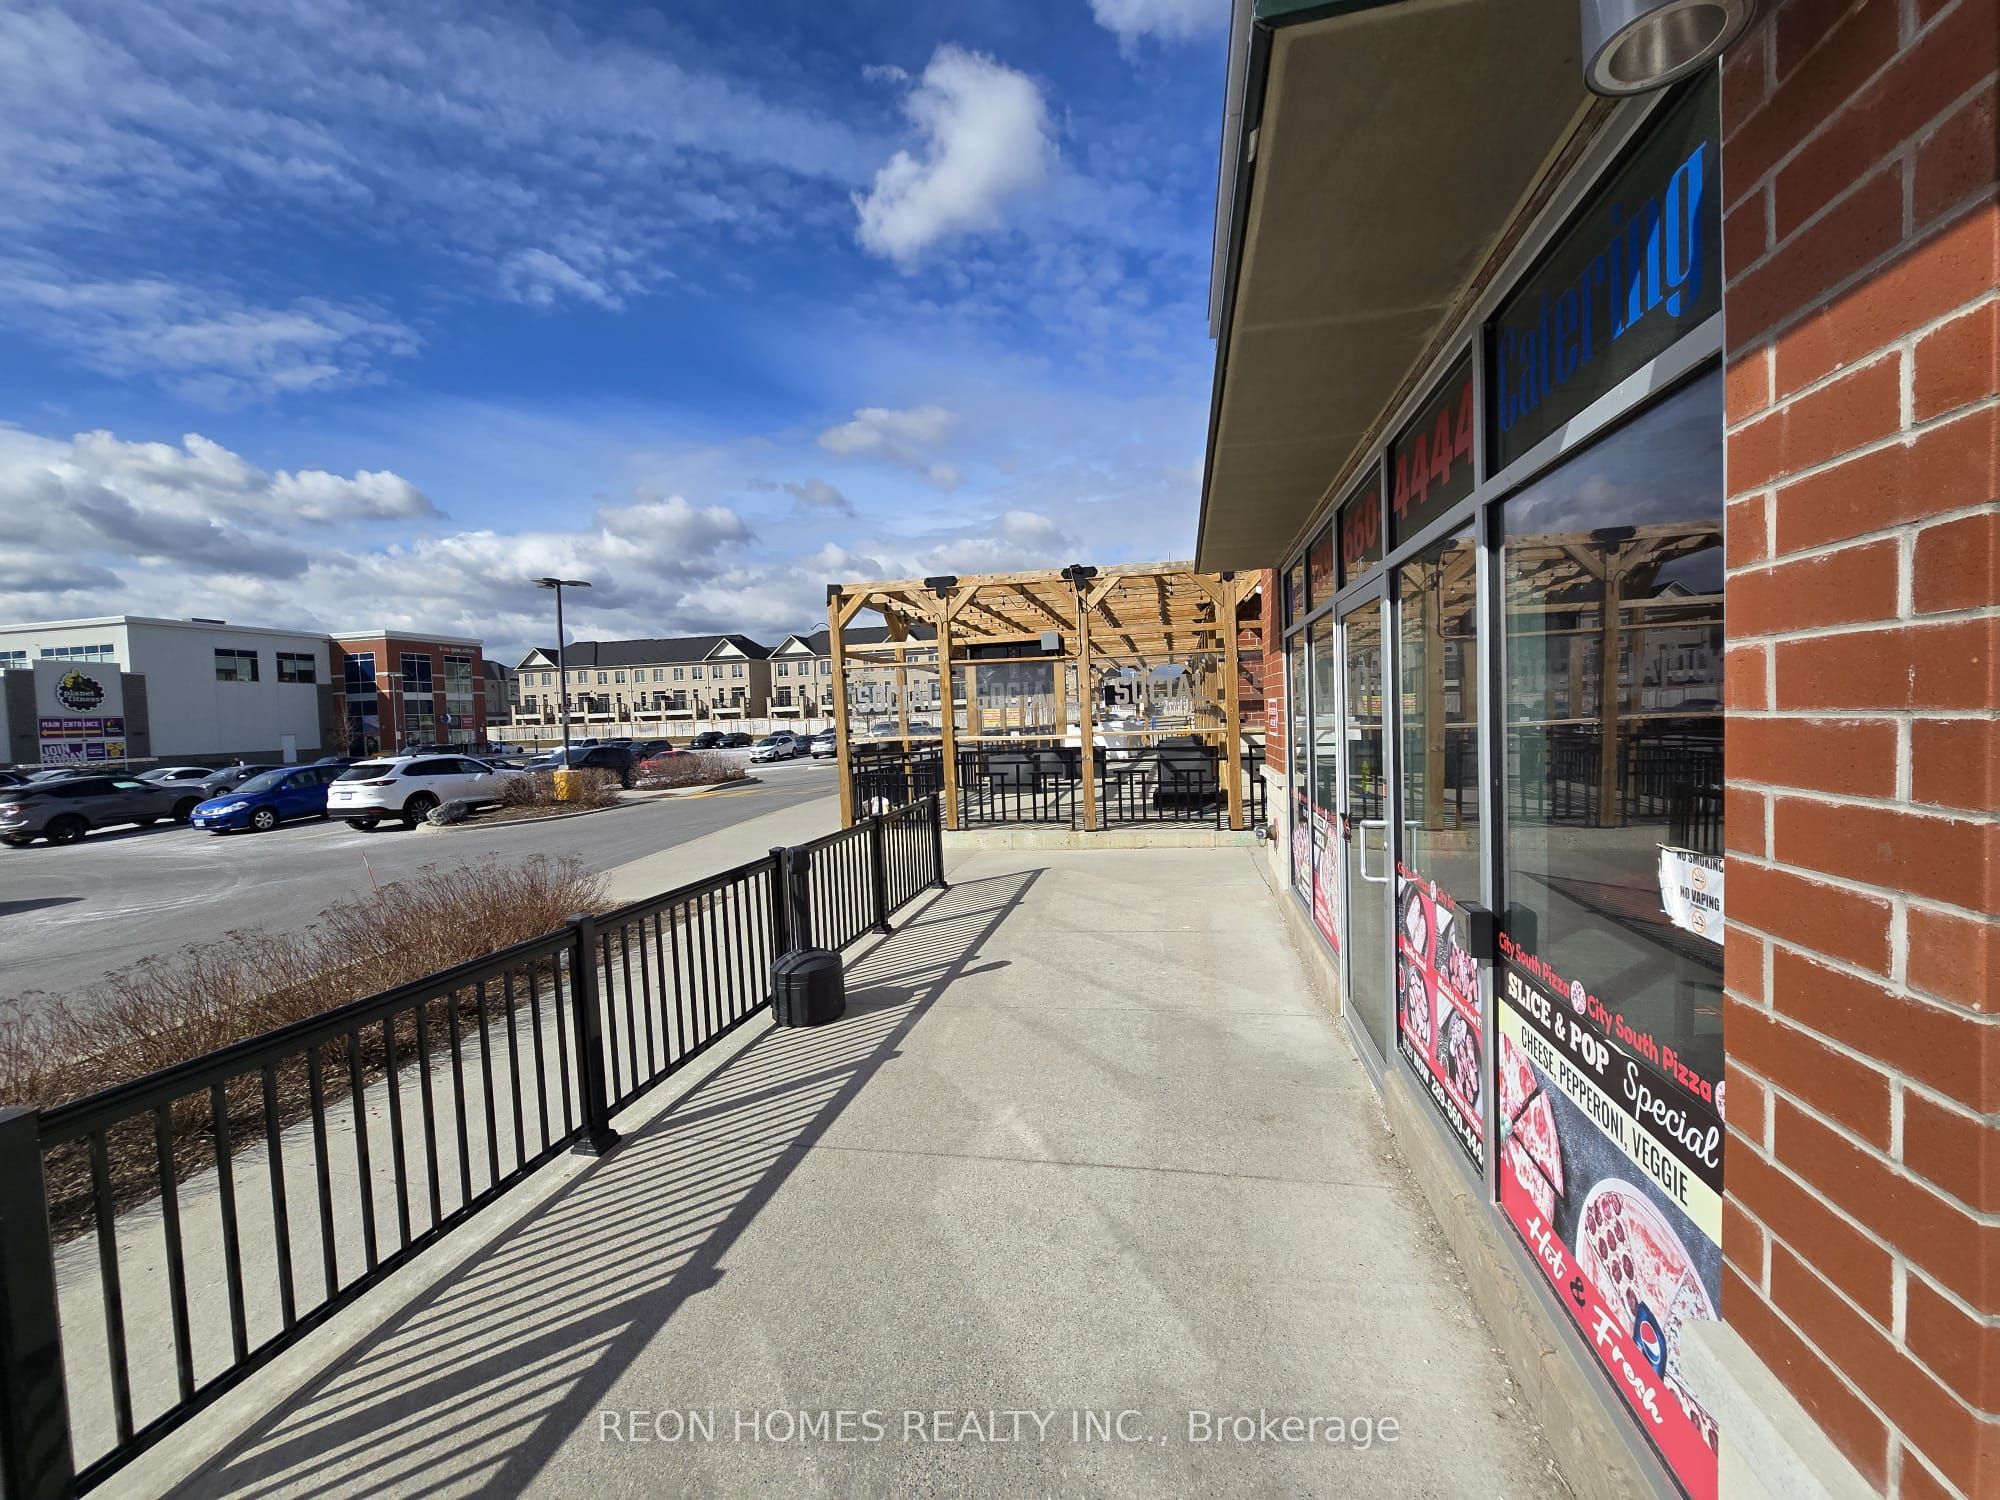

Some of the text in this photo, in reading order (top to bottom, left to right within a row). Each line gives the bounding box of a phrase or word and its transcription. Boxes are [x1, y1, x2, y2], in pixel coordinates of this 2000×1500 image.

[1500, 139, 1707, 432] Catering
[1393, 376, 1474, 520] 4444
[64, 689, 95, 698] planet
[1114, 671, 1212, 705] SOCIAL
[43, 743, 70, 756] JOIN
[1680, 885, 1690, 900] NO
[1691, 888, 1720, 912] VAPING
[1499, 931, 1570, 996] City South Pizza
[1508, 971, 1720, 1169] SLICE & POP Special
[1586, 995, 1712, 1103] City South Pizza
[1431, 1075, 1484, 1166] 289-660-444
[1521, 1025, 1688, 1206] CHEESE, PEPPERONI, VEGGIE
[1526, 1217, 1664, 1425] Hot & Fresh
